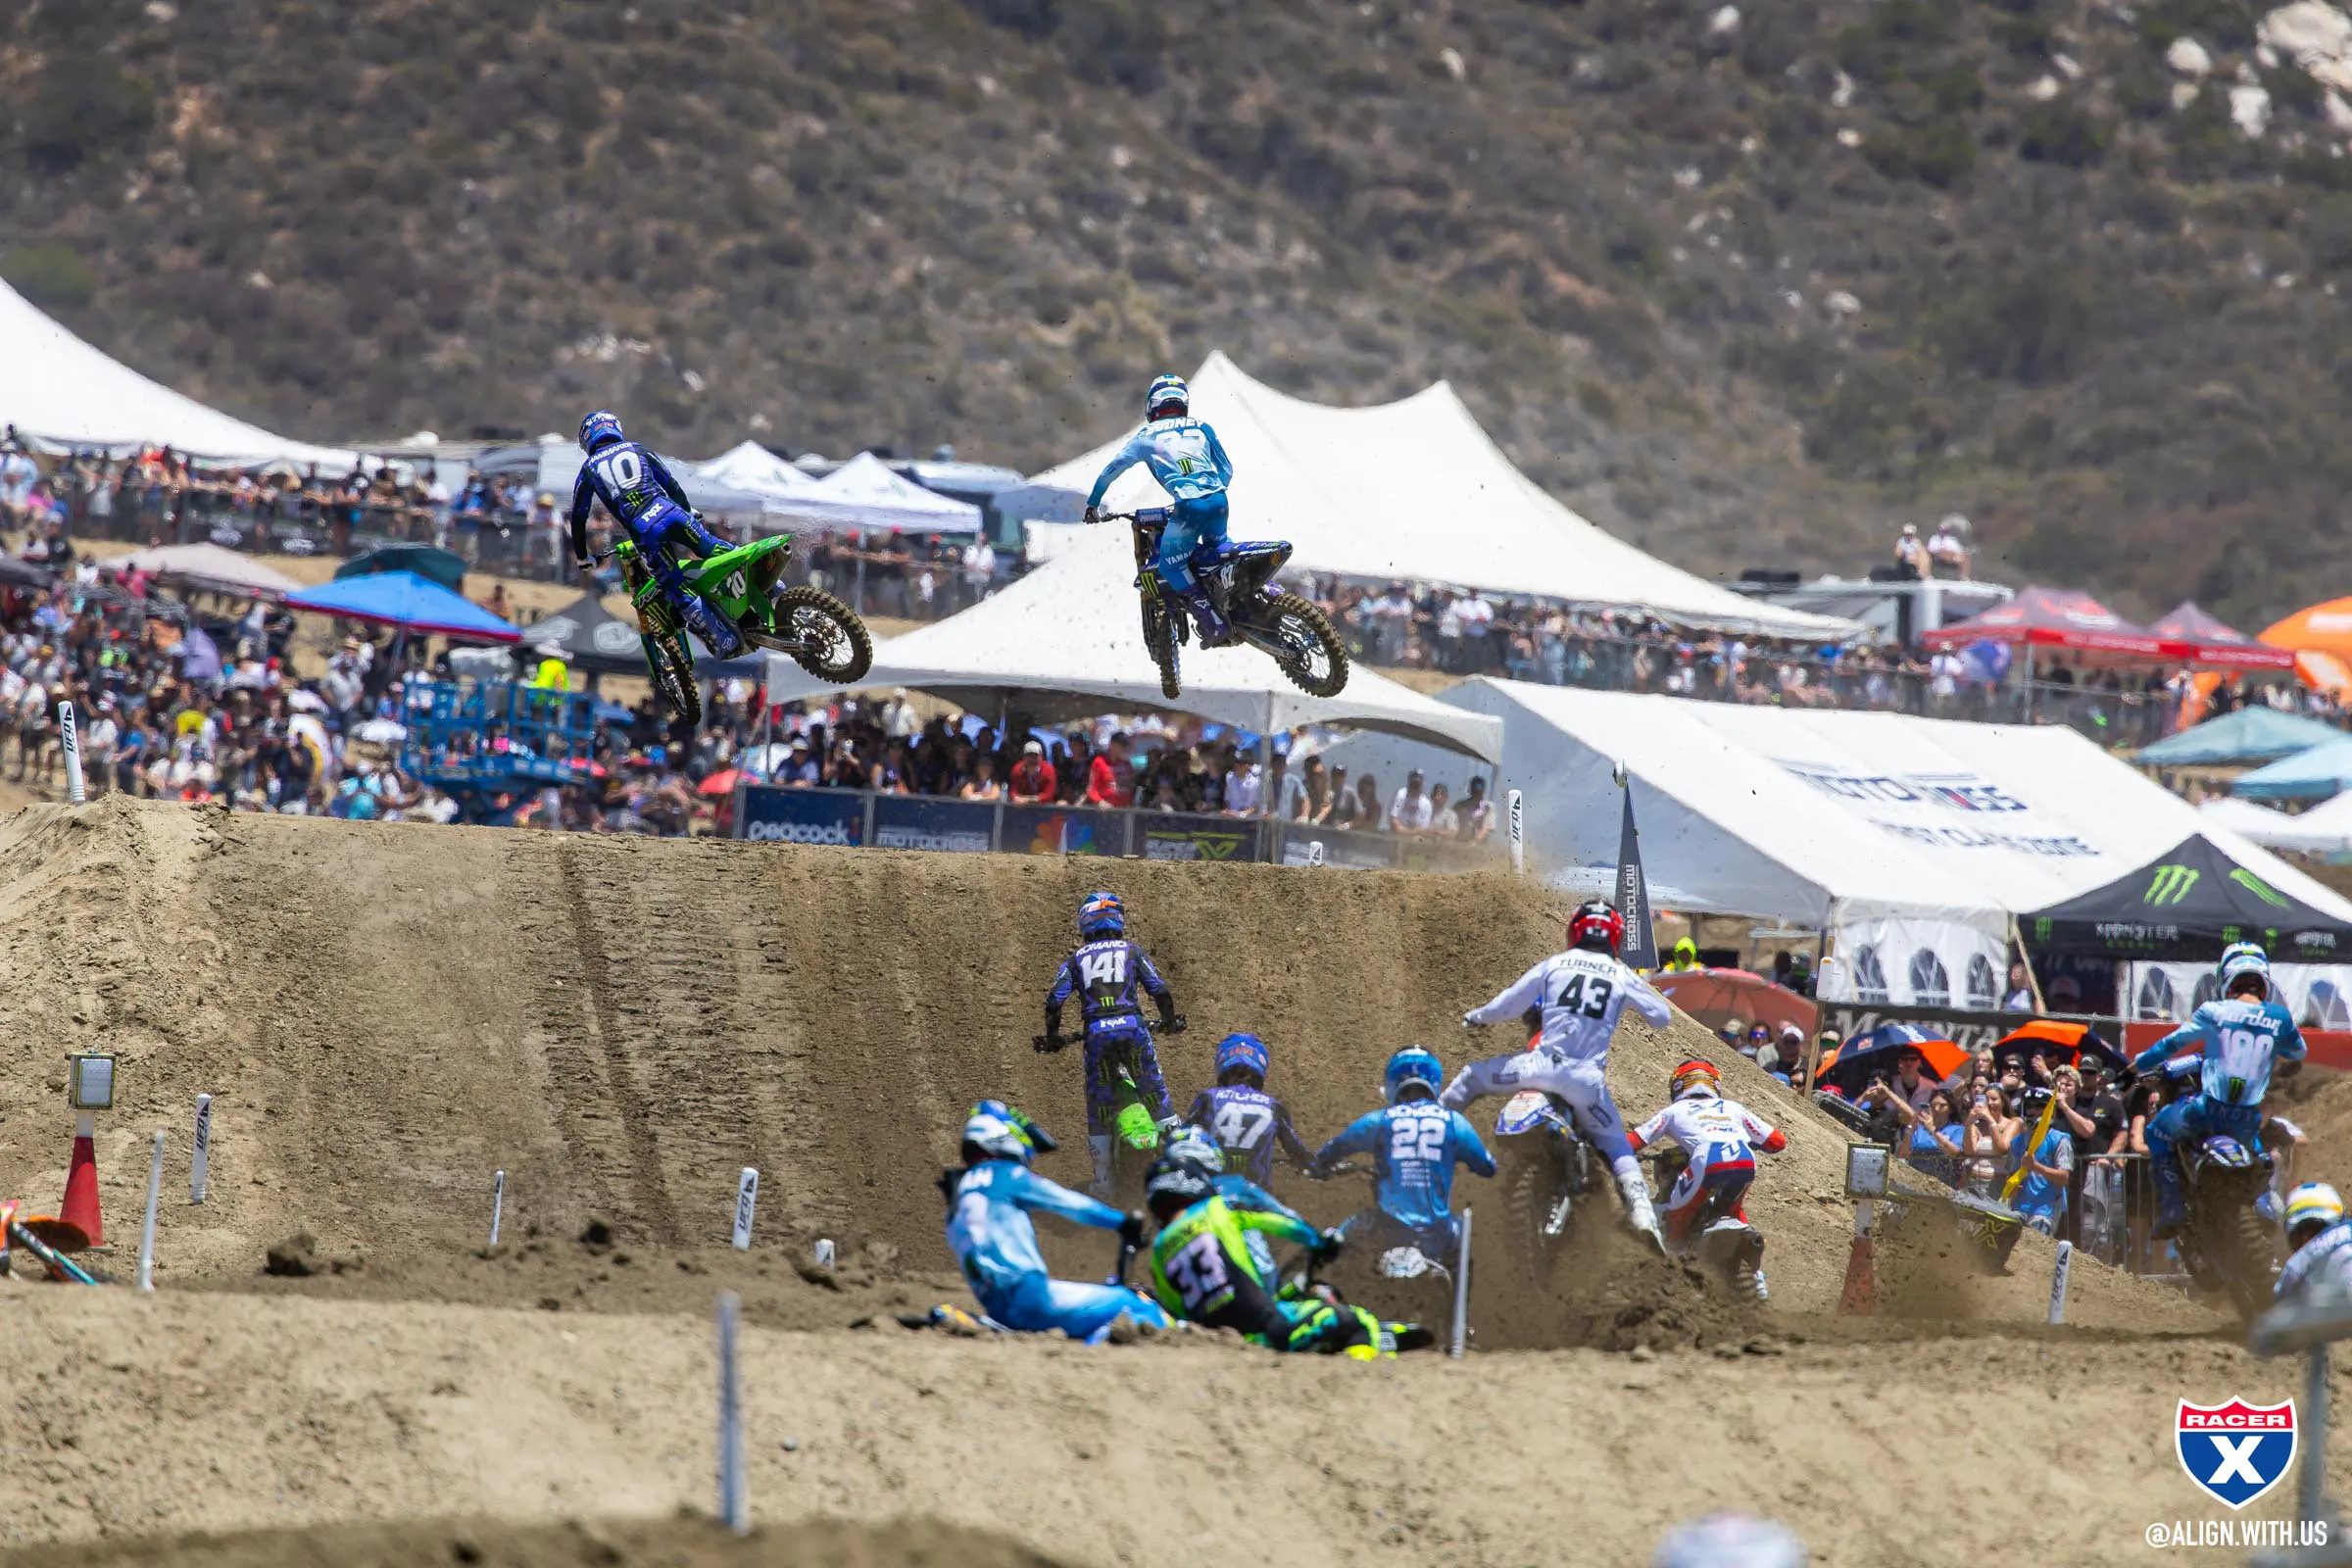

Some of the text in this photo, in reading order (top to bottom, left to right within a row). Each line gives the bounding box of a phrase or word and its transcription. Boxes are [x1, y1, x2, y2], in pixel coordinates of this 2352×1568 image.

[596, 450, 642, 500] 10
[642, 503, 663, 522] FOX
[726, 570, 746, 600] 10
[748, 819, 850, 846] peacock
[1625, 863, 1638, 952] MOTOCROSS
[1076, 940, 1128, 957] ROMANO
[1559, 958, 1617, 976] TURNER
[1080, 950, 1126, 990] 141
[1556, 973, 1613, 1019] 43
[1100, 1016, 1127, 1028] FOX
[1214, 1102, 1274, 1150] 47
[1392, 1117, 1446, 1161] 22
[1165, 1232, 1228, 1310] 33
